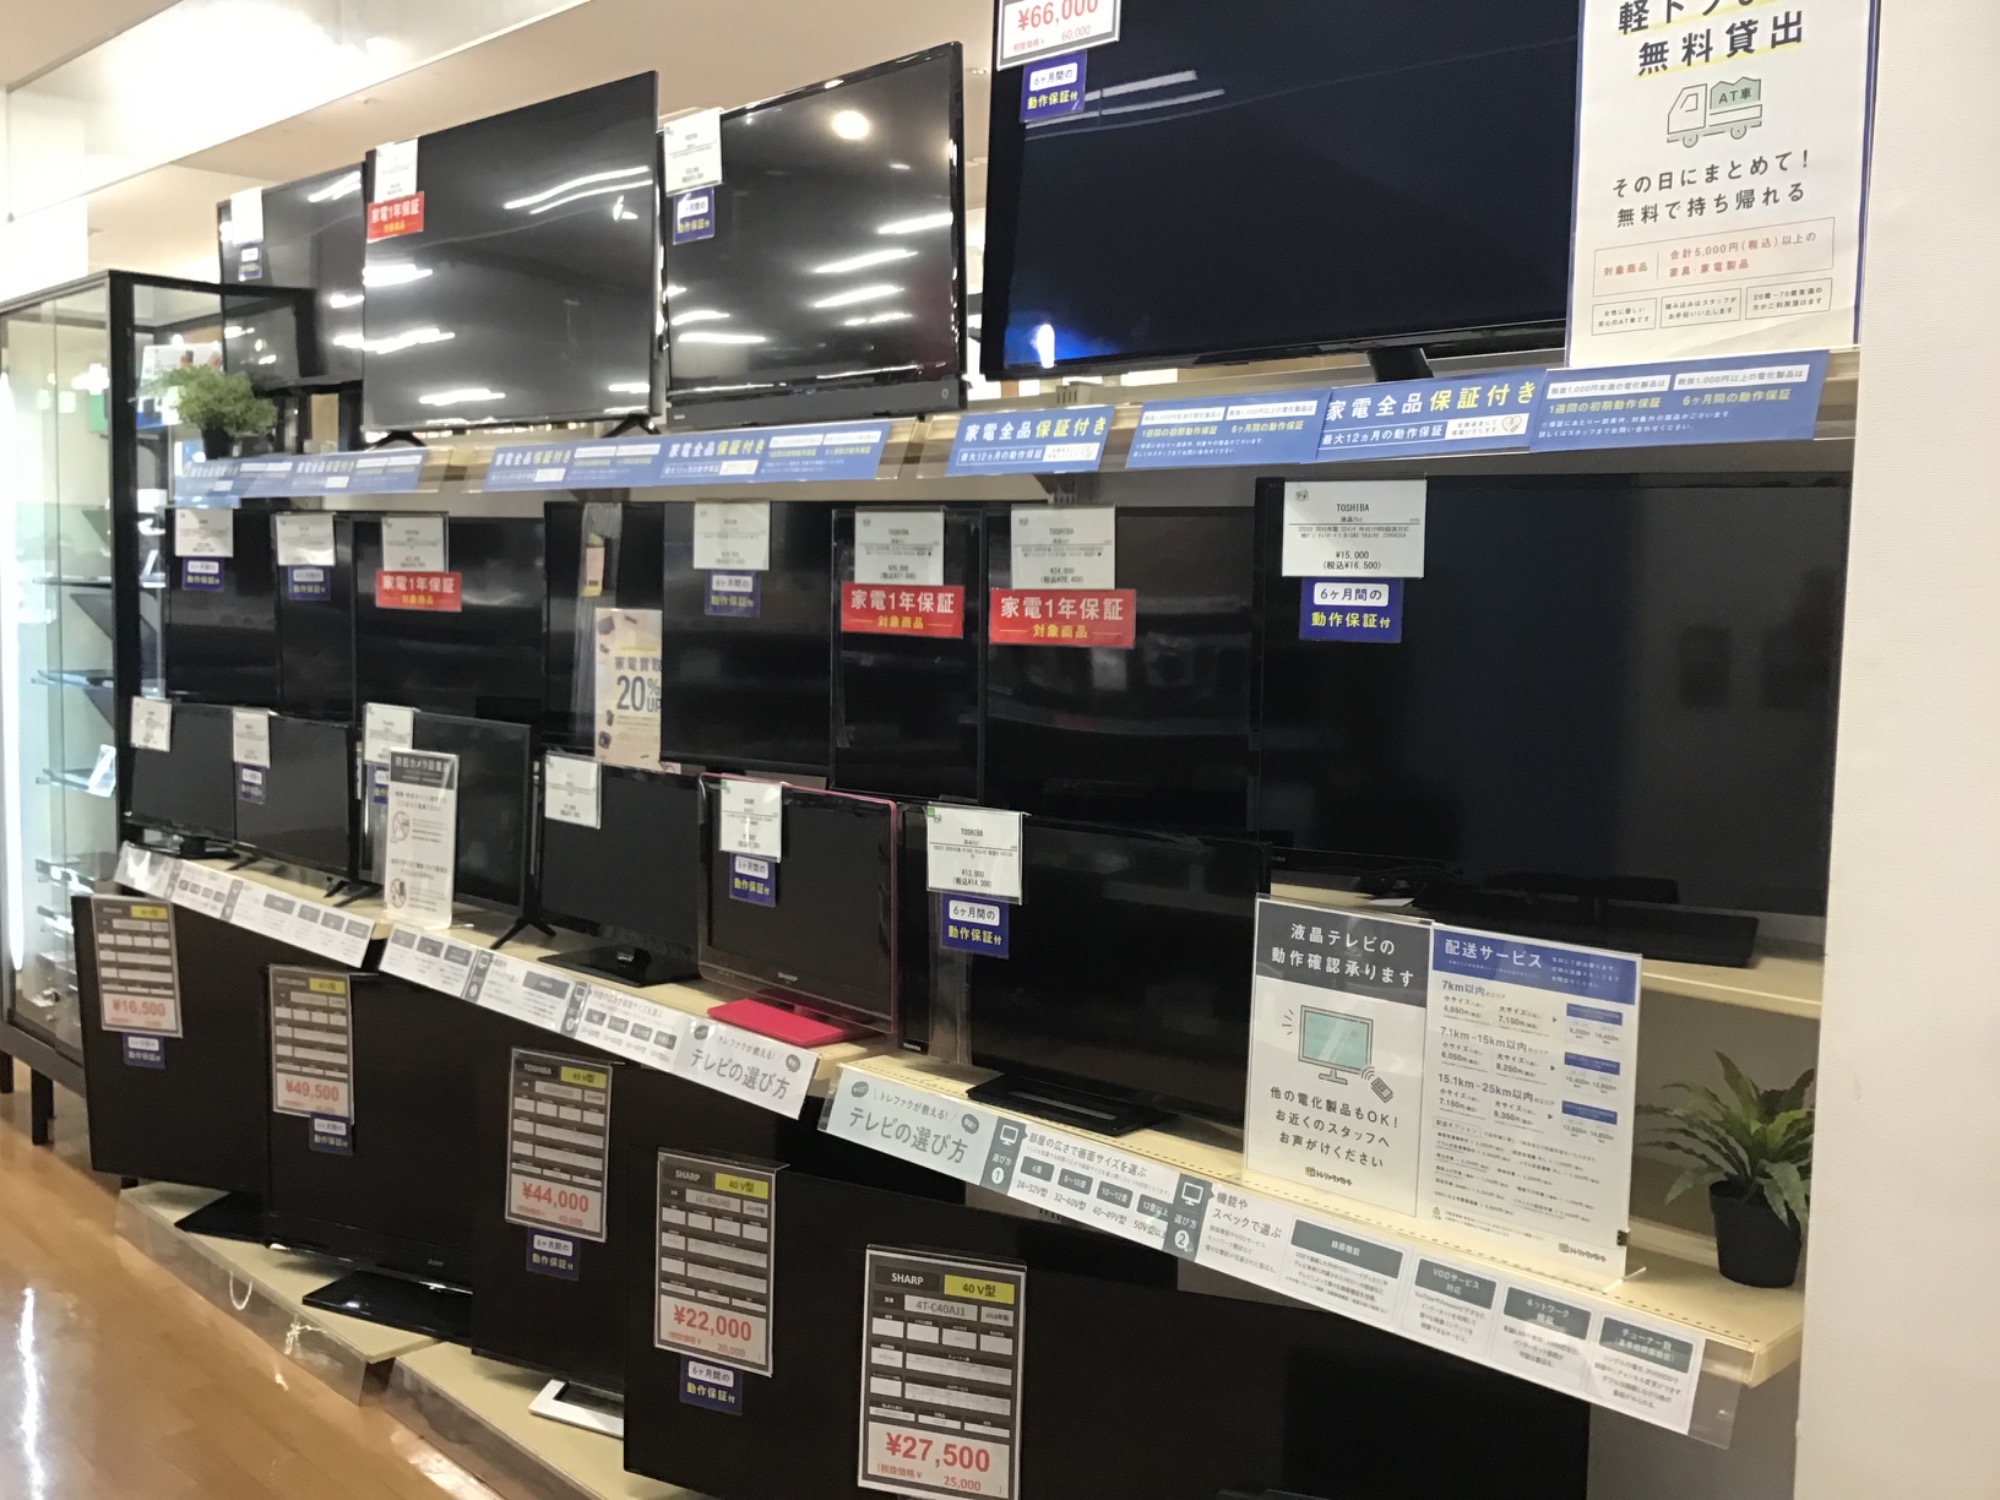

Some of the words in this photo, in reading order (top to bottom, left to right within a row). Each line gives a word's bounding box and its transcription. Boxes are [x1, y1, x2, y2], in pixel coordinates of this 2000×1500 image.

[1061, 25, 1091, 41] 60,000
[1638, 10, 1803, 76] 無料貸出
[1027, 91, 1078, 110] 動作保証付
[1718, 87, 1753, 105] AT車
[1612, 149, 1809, 198] その日にまとめて!
[1617, 182, 1805, 228] 無料で持ち帰れる
[1603, 262, 1648, 277] 対象商品
[1325, 381, 1537, 422] 家電全品保証付き
[1549, 396, 1661, 415] 1週間の初期動作保証
[1682, 388, 1791, 406] 6ヶ月間の動作保証
[964, 416, 1107, 443] 家電全品保証付き
[1336, 503, 1370, 512] TOSHIBA
[1335, 551, 1370, 560] ¥15,000
[850, 588, 955, 614] 家電1年保証
[1320, 587, 1383, 601] 6ヶ月間の
[1000, 595, 1124, 621] 家電1年保証
[1311, 610, 1392, 629] 動作保証付
[877, 614, 924, 630] 対象商品
[1032, 623, 1088, 639] 対象商品
[953, 906, 996, 921] 6ヶ月間の
[947, 924, 1003, 947] 動作保証付
[1290, 922, 1396, 956] 液晶テレビの
[1444, 938, 1542, 969] 配送サービス
[1271, 946, 1415, 988] 動作確認承ります
[689, 1048, 791, 1100] テレビの選び方
[285, 1079, 340, 1102] ¥49,500
[880, 1091, 949, 1121] トレファクが教える!
[1270, 1085, 1399, 1129] 他の電化製品もOK!
[849, 1106, 969, 1164] テレビの選び方
[1275, 1109, 1390, 1148] お近くのスタッフへ
[1028, 1132, 1148, 1178] 部屋の広さで画面サイズを選ぶ
[1279, 1131, 1385, 1169] お声がけください
[675, 1169, 700, 1182] SHARP
[522, 1181, 589, 1213] ¥44,000
[1216, 1191, 1249, 1209] 機能や
[1173, 1213, 1198, 1230] 選び方
[1212, 1207, 1283, 1240] スペックで選ぶ
[891, 1272, 924, 1286] SHARP
[1432, 1267, 1480, 1290] VODサービス
[962, 1283, 975, 1294] 40
[977, 1284, 996, 1298] V型
[673, 1304, 752, 1342] ¥22,000
[885, 1431, 991, 1473] ¥27,500
[943, 1475, 982, 1492] 25,000
